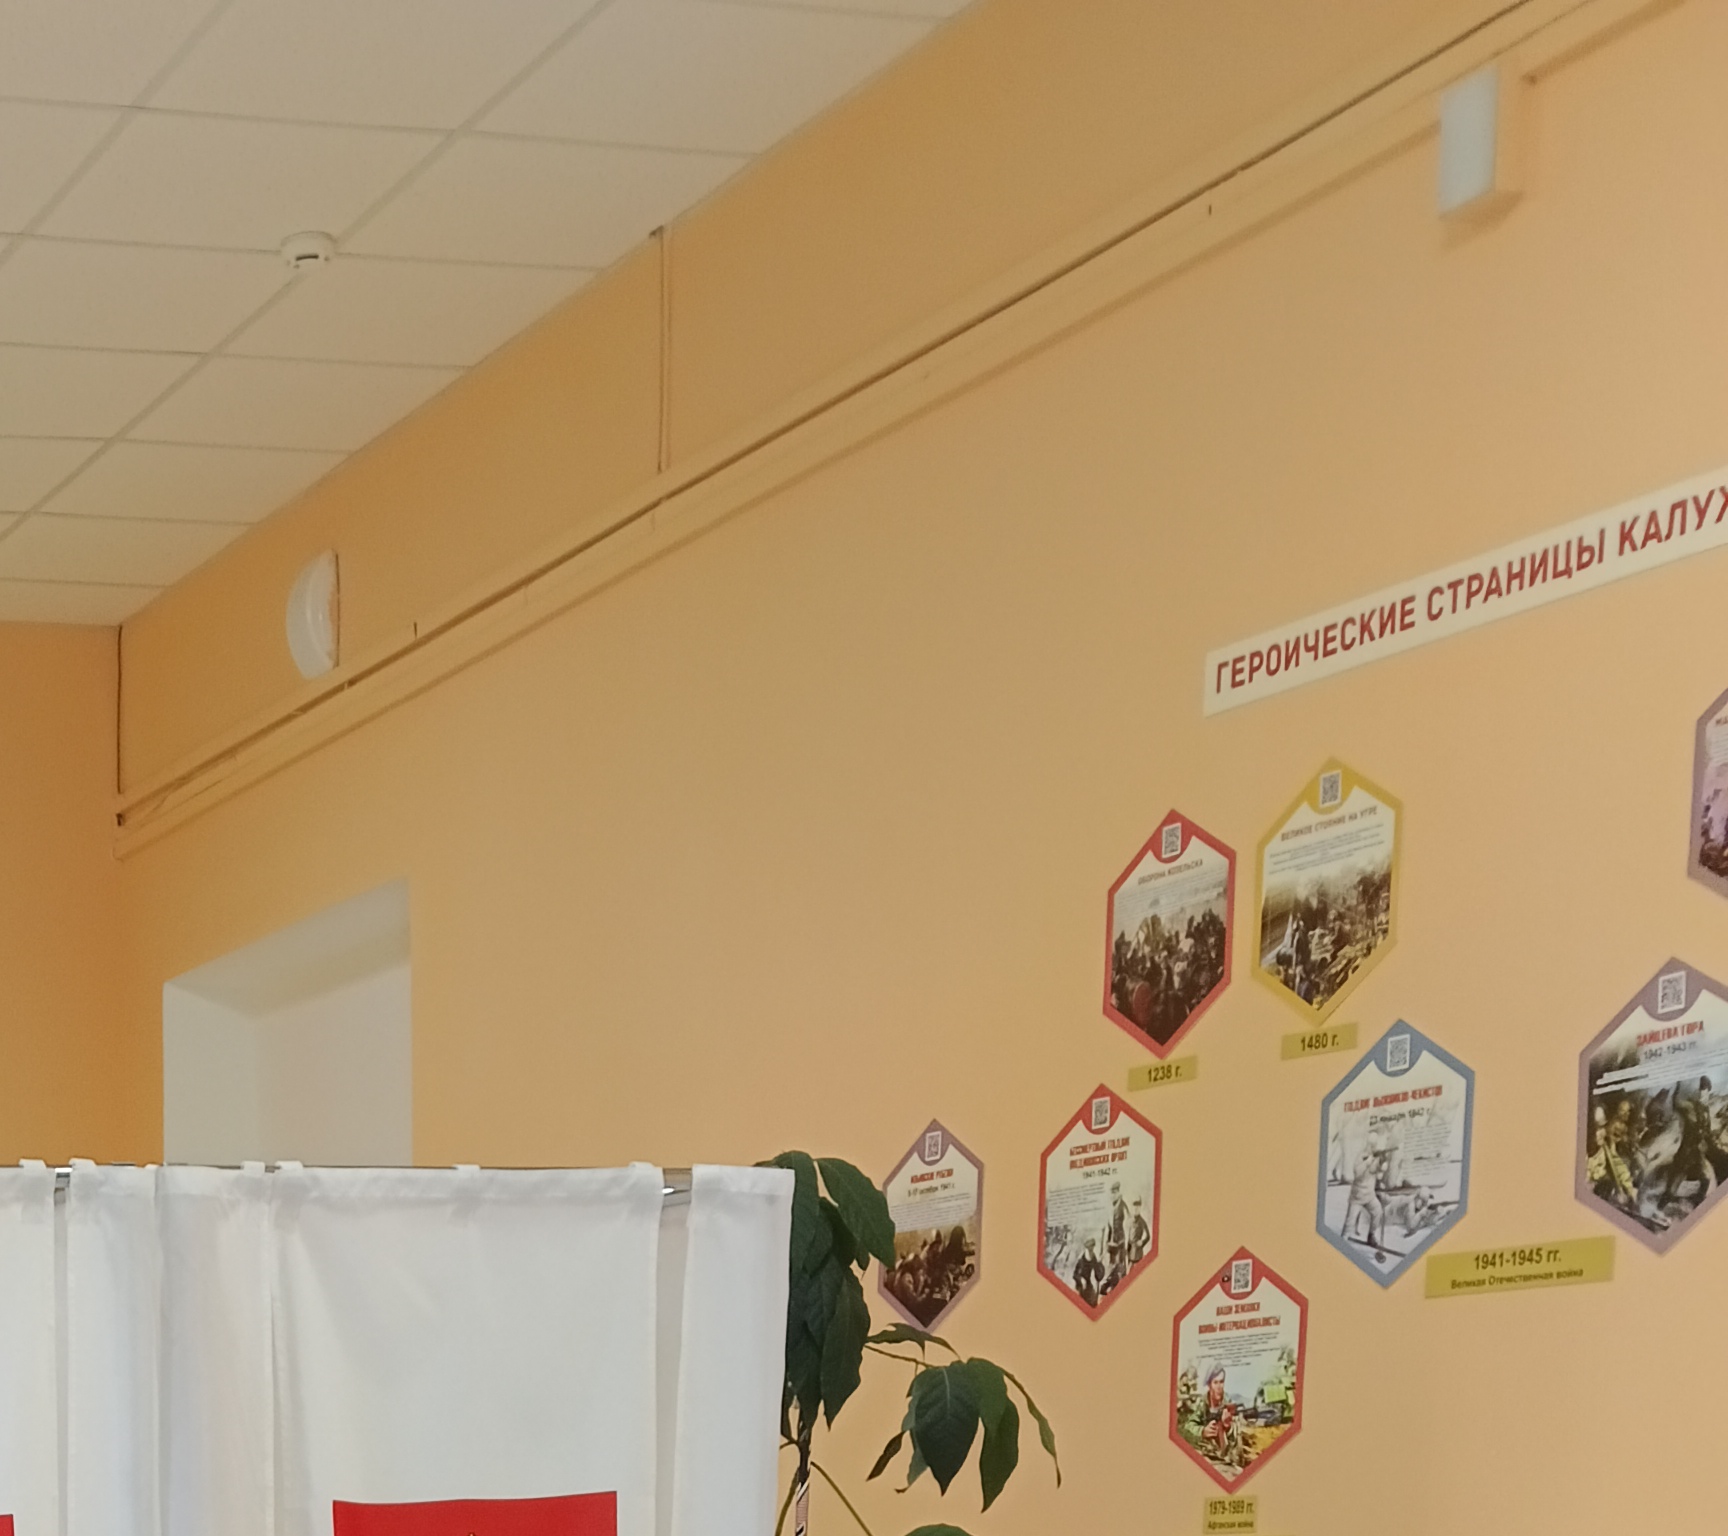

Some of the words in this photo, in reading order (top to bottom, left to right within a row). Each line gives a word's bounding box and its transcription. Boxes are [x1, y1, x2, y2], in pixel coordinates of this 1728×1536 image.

[1215, 594, 1418, 695] ГЕРОИЧЕСКИЕ
[1426, 527, 1607, 622] СТРАНИЦЫ
[1300, 1032, 1328, 1052] 1480
[1332, 1032, 1340, 1047] г.
[1147, 1064, 1173, 1083] 1238
[1175, 1064, 1183, 1078] г.
[1473, 1247, 1544, 1270] 1941-1945
[1546, 1249, 1562, 1263] гг.
[1450, 1278, 1487, 1290] Великая
[1488, 1271, 1554, 1287] Отечественная
[1556, 1268, 1584, 1280] война
